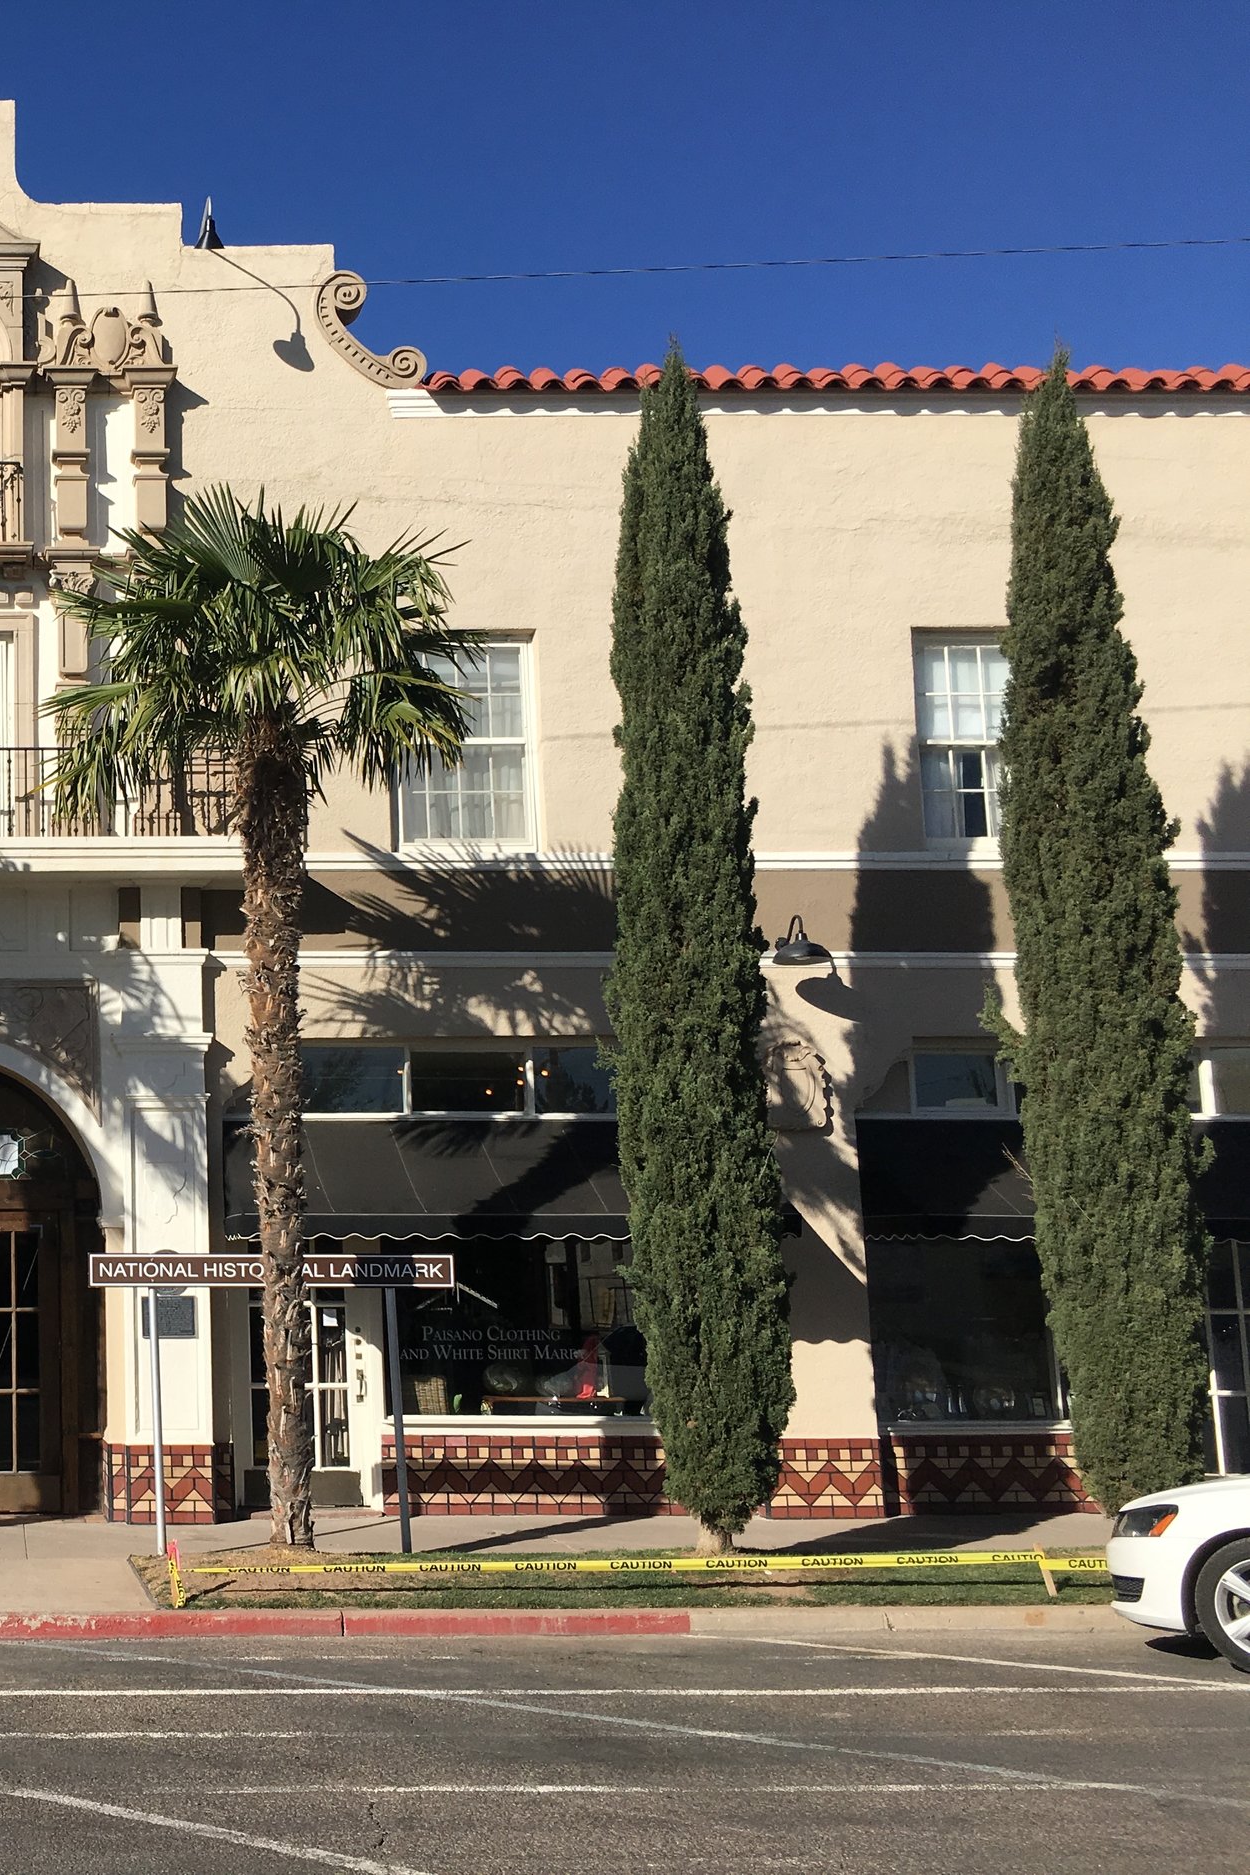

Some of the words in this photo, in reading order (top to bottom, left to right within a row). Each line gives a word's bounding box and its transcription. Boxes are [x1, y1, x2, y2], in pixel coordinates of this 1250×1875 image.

[99, 1262, 198, 1278] NATIONAL
[203, 1262, 324, 1278] HISTOAL
[330, 1263, 443, 1278] LANDMARK
[419, 1563, 481, 1572] CAUTION
[515, 1562, 577, 1571] CAUTION
[610, 1561, 672, 1570] CAUTION
[706, 1559, 768, 1569] CAUTION
[801, 1557, 864, 1567] CAUTION
[896, 1555, 959, 1565] CAUTION
[992, 1554, 1044, 1562] CAUTIO
